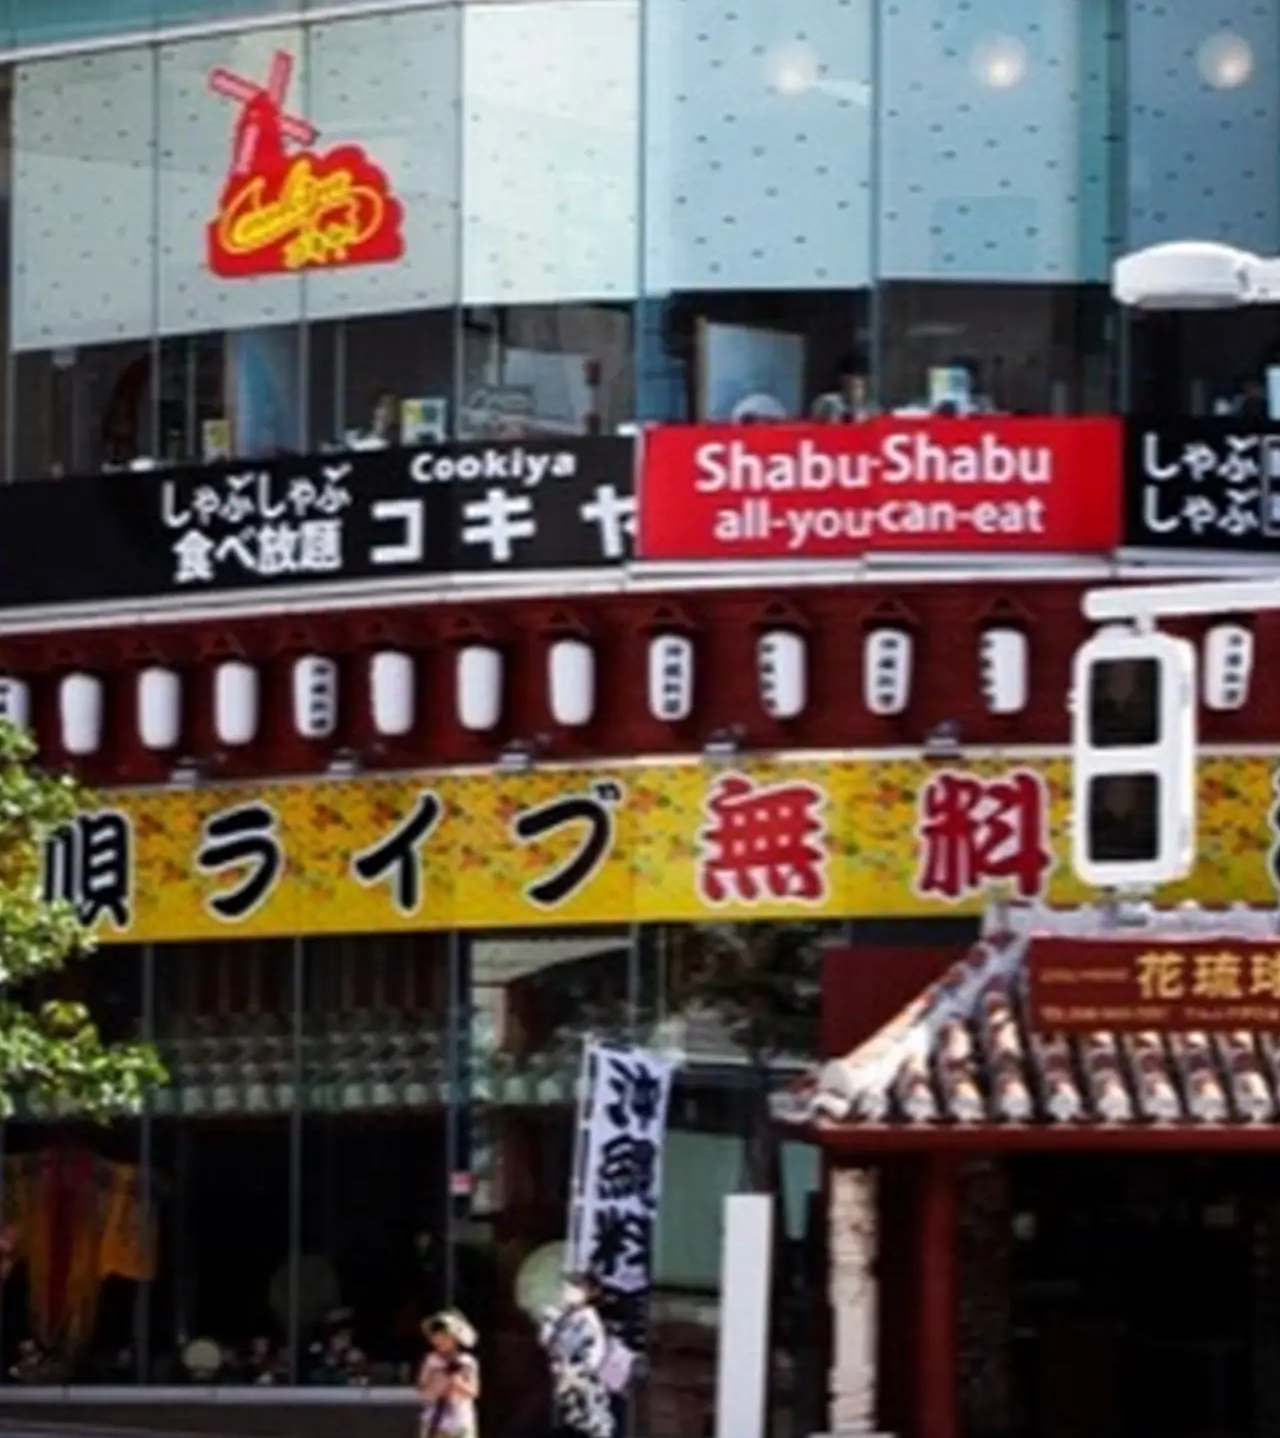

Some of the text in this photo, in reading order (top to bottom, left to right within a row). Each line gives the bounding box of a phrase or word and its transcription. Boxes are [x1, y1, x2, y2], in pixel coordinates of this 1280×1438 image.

[410, 450, 577, 485] Cookiya
[1142, 433, 1260, 480] しゃぶ
[160, 463, 353, 527] しゃぶしゃぶ
[1142, 484, 1260, 534] しゃぶ
[172, 521, 343, 584] 食べ放題
